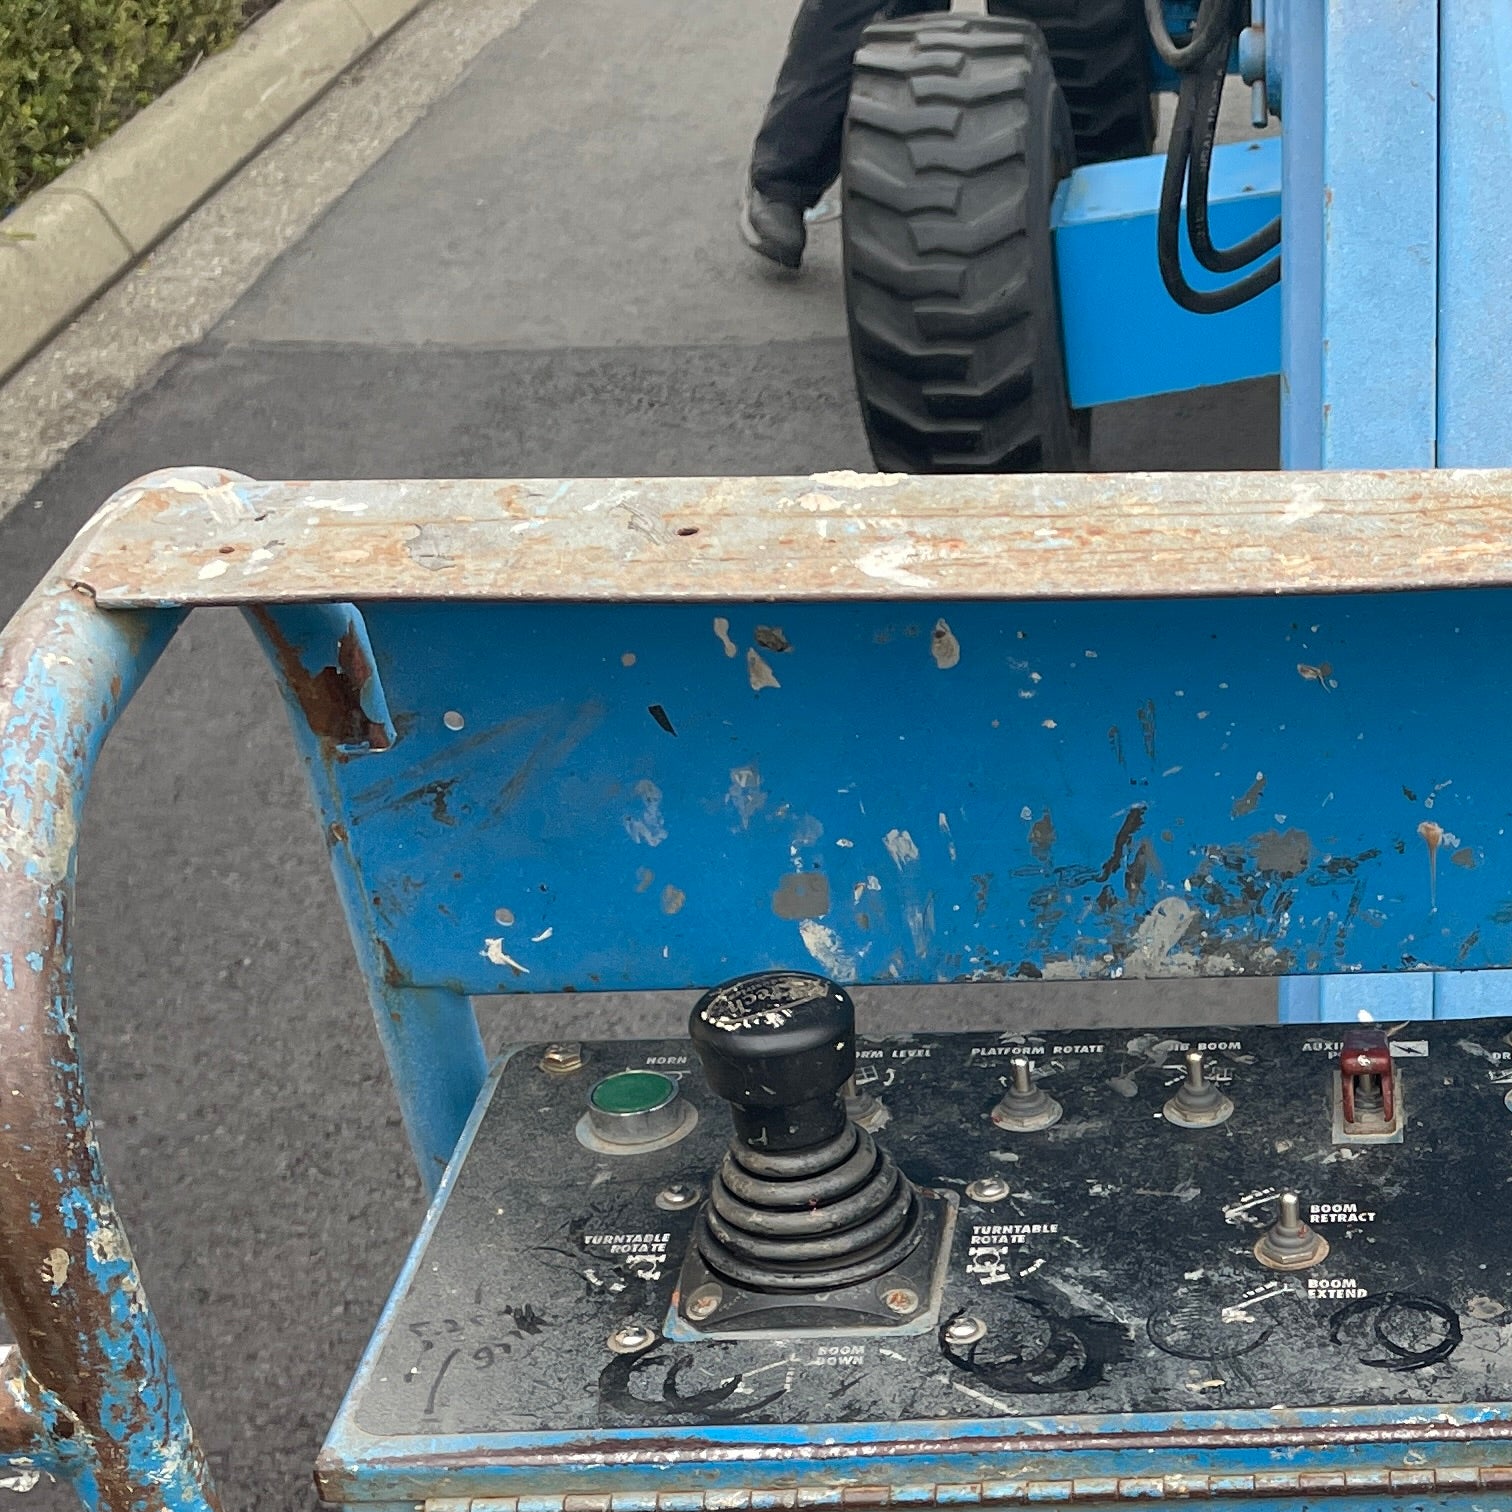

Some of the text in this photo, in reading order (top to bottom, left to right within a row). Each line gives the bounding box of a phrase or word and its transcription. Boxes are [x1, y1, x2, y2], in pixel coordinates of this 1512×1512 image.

[971, 1044, 1105, 1056] PLATFORM ROTATE
[1198, 1042, 1242, 1051] BOOM
[892, 1049, 931, 1058] LEVEL
[646, 1055, 688, 1065] HORN
[1310, 1204, 1358, 1214] BOOM
[1310, 1212, 1376, 1223] RETRACT
[973, 1223, 1059, 1235] TURNTABLE
[584, 1233, 671, 1246] TURNTABLE
[971, 1234, 1027, 1245] ROTATE
[610, 1243, 667, 1254] ROTATE
[1308, 1278, 1357, 1289] BOOM
[1308, 1288, 1368, 1299] EXTEND
[819, 1345, 866, 1356] BOOM
[819, 1354, 865, 1365] DOWN
